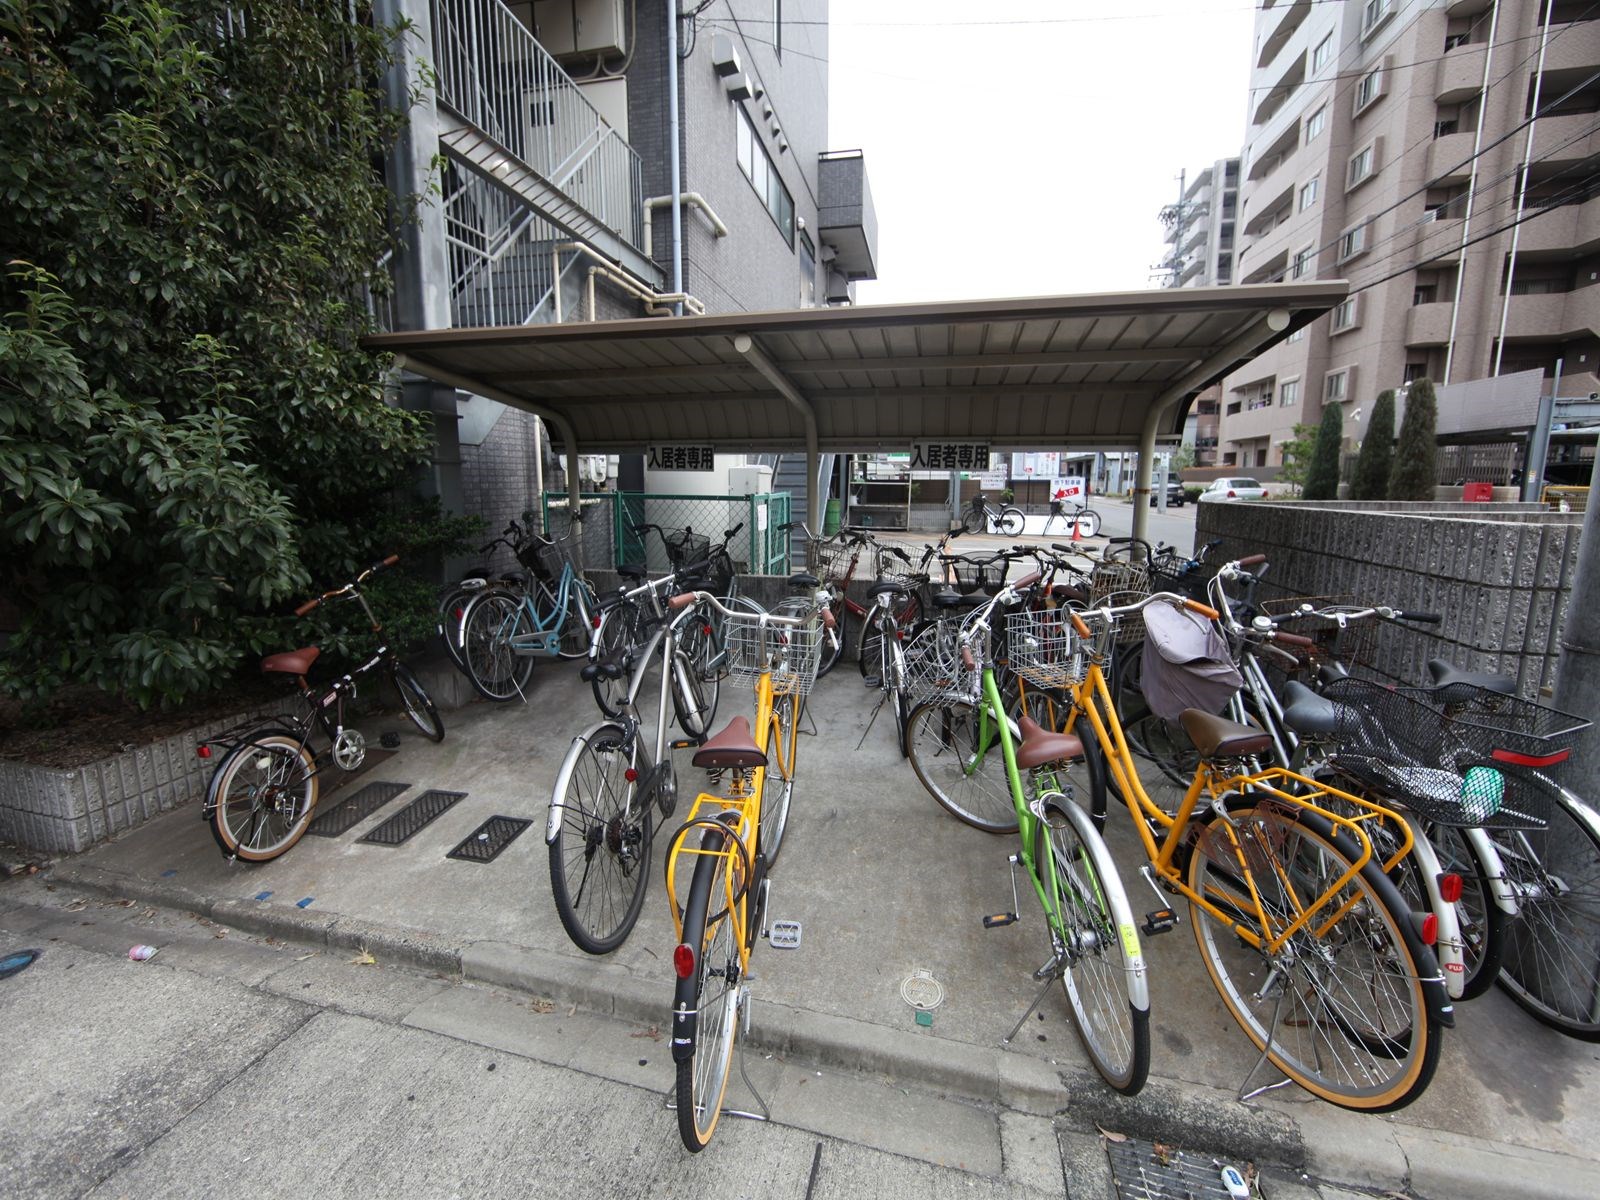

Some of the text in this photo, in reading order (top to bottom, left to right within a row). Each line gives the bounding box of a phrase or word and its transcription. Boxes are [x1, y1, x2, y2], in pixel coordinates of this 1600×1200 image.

[648, 446, 714, 469] 入居者専用
[911, 444, 989, 469] 入居者専用
